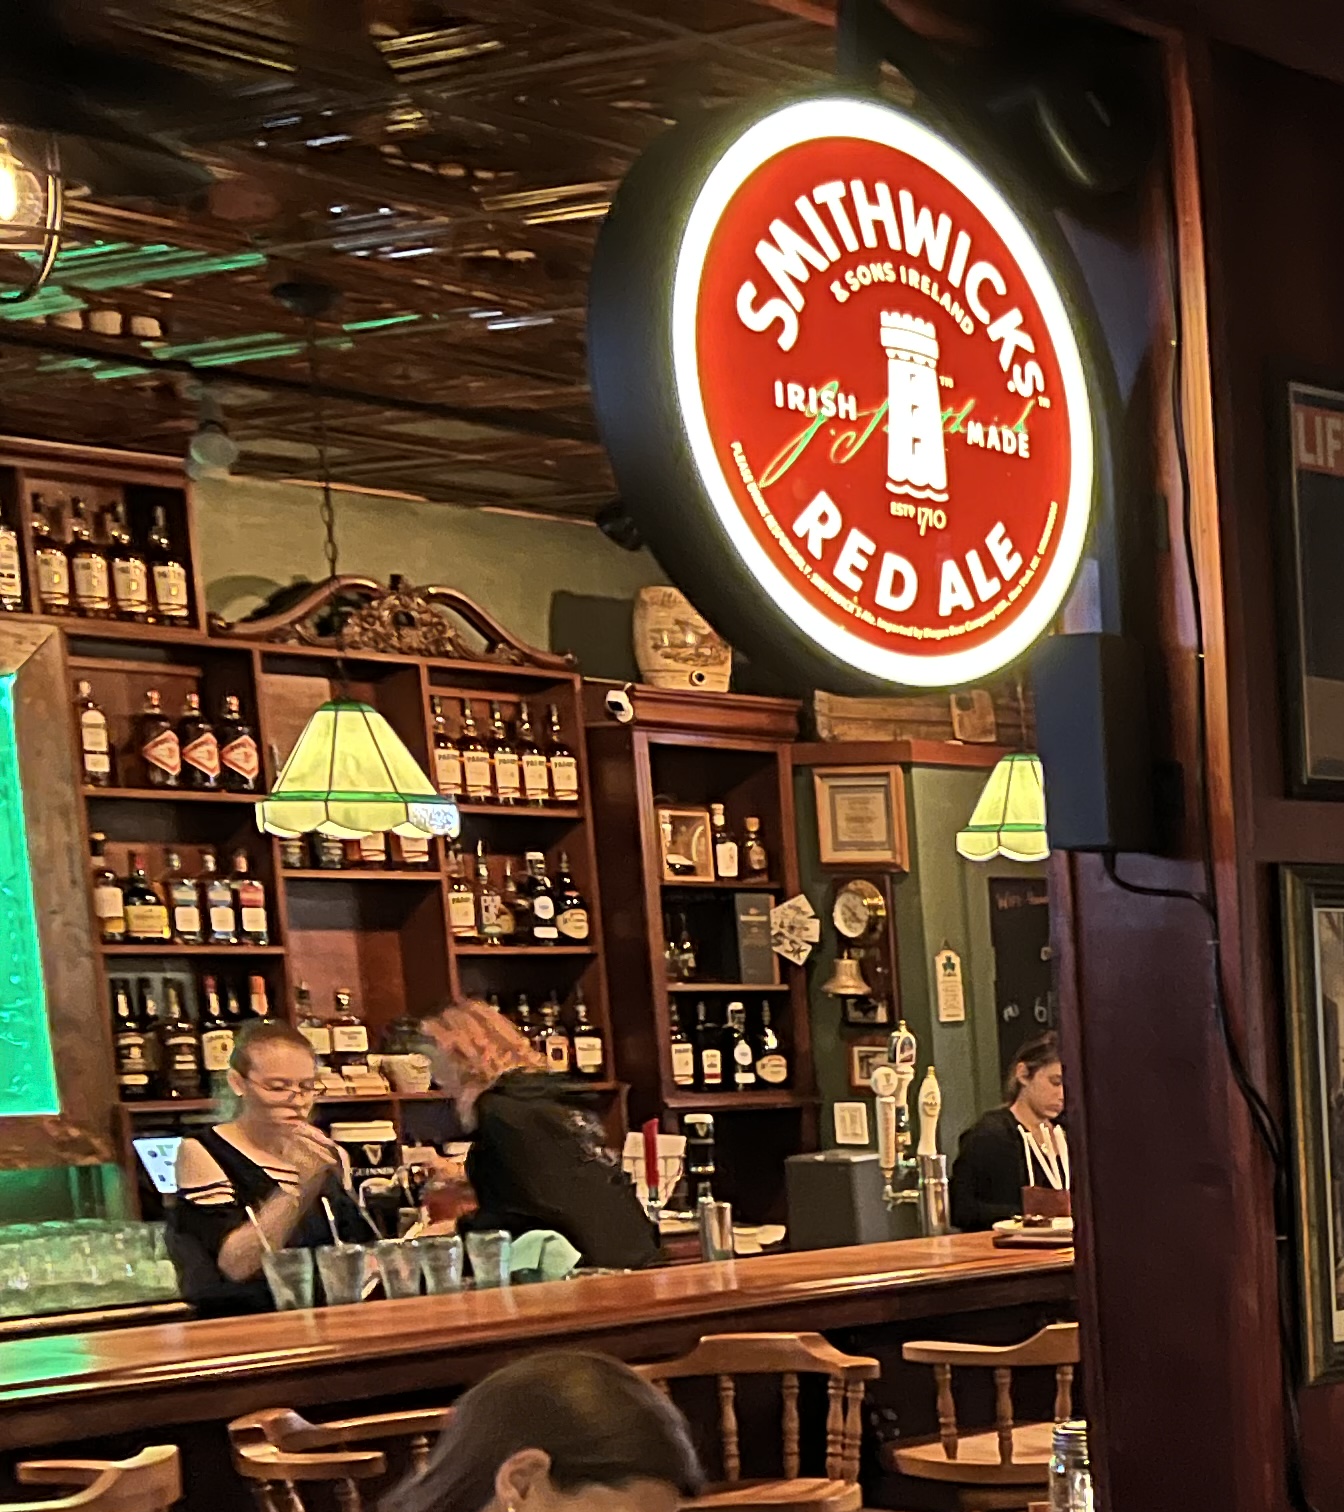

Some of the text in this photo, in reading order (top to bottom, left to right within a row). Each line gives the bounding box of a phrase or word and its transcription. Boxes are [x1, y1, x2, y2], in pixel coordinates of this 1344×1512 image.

[830, 262, 974, 335] & SONS IRELAND
[775, 379, 1030, 458] IRISH MADE
[792, 488, 919, 612] RED
[938, 520, 1024, 617] ALE
[917, 506, 947, 537] 1710
